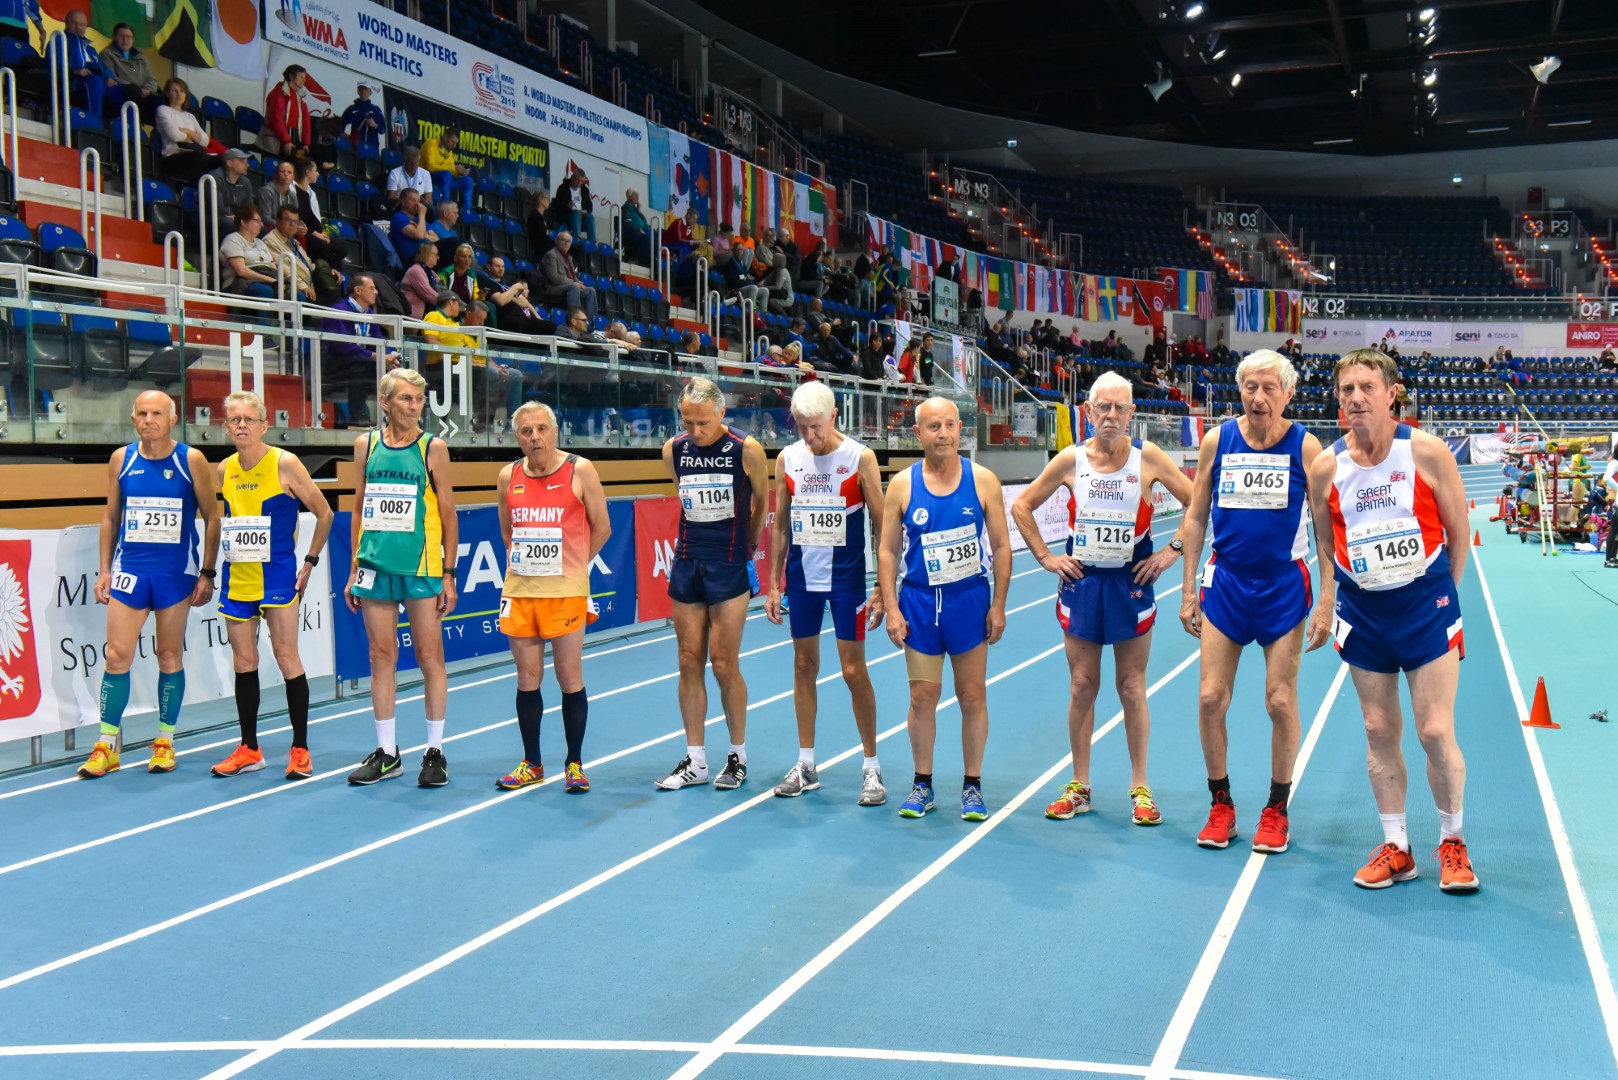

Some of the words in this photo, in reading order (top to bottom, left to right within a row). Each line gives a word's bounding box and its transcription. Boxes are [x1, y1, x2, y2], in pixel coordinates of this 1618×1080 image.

[302, 13, 348, 51] WMA
[357, 11, 403, 45] WORLD
[405, 32, 458, 67] MASTERS
[281, 30, 301, 42] WORLD
[323, 46, 349, 60] ATHLETICS
[358, 40, 423, 78] ATHLETICS
[501, 95, 516, 108] 2019
[523, 85, 530, 98] 8.
[531, 87, 552, 106] WORLD
[551, 96, 577, 116] MASTERS
[576, 104, 603, 126] ATHLETICS
[602, 117, 643, 142] CHAMPIONSHIPS
[524, 103, 547, 123] INDOOR
[550, 114, 590, 138] 24-30.03.2019
[459, 130, 507, 160] MIASTEM
[509, 142, 546, 168] SPORTU
[954, 178, 970, 196] M3
[974, 181, 989, 199] N3
[1217, 211, 1234, 226] N3
[1550, 219, 1569, 233] P3
[1303, 298, 1319, 313] N2
[1306, 327, 1327, 338] seni
[1398, 330, 1432, 338] APATOR
[1455, 329, 1481, 341] seni
[1572, 331, 1600, 341] ANIRO
[965, 350, 975, 376] K1
[429, 353, 468, 417] J1
[838, 393, 853, 432] J1
[679, 456, 733, 468] FRANCE
[368, 469, 421, 484] AUSTRALIA
[803, 473, 832, 482] GREAT
[1090, 478, 1123, 489] GREAT
[1243, 471, 1285, 488] 0465
[235, 482, 258, 491] sverige
[800, 484, 833, 493] BRITAIN
[1356, 484, 1393, 500] GREAT
[697, 489, 730, 505] 1104
[1088, 489, 1124, 501] BRITAIN
[380, 499, 412, 514] 0087
[1356, 496, 1397, 513] BRITAIN
[144, 512, 178, 527] 2513
[511, 507, 565, 523] GERMANY
[809, 513, 843, 528] 1489
[235, 532, 267, 546] 4006
[1094, 527, 1131, 544] 1216
[526, 544, 559, 559] 2009
[946, 541, 977, 564] 2383
[1374, 537, 1420, 562] 1469
[115, 574, 131, 590] 10
[357, 569, 365, 585] 8
[500, 600, 507, 615] 7
